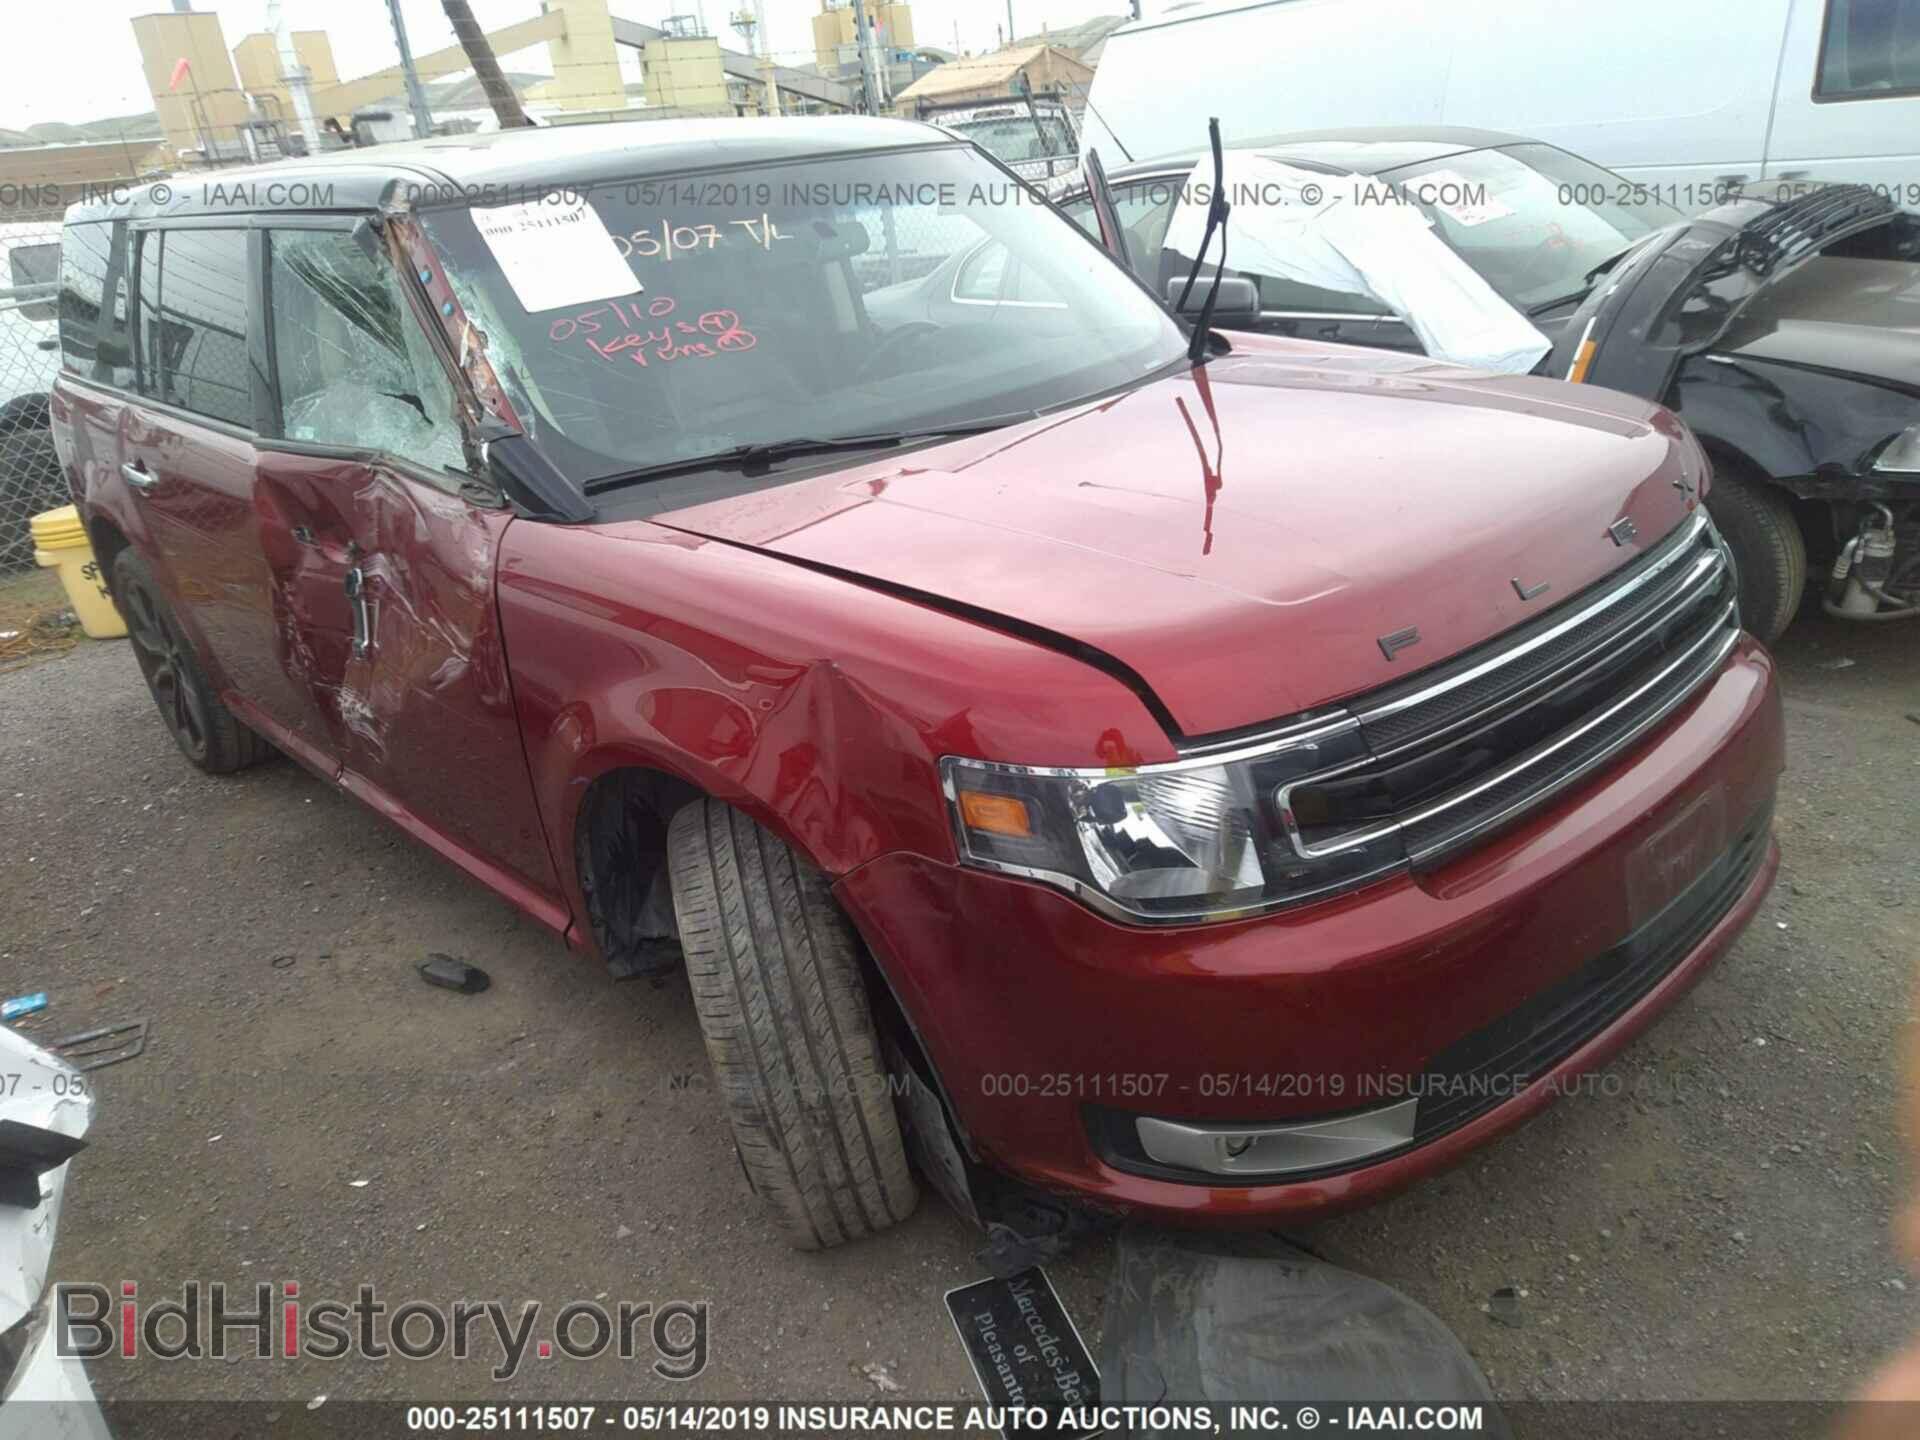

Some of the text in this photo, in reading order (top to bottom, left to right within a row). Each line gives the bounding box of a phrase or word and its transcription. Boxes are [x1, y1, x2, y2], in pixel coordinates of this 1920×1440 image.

[974, 1311, 1027, 1411] Pleasanto
[1008, 1276, 1086, 1413] Mercedes-Be
[1013, 1344, 1039, 1365] of
